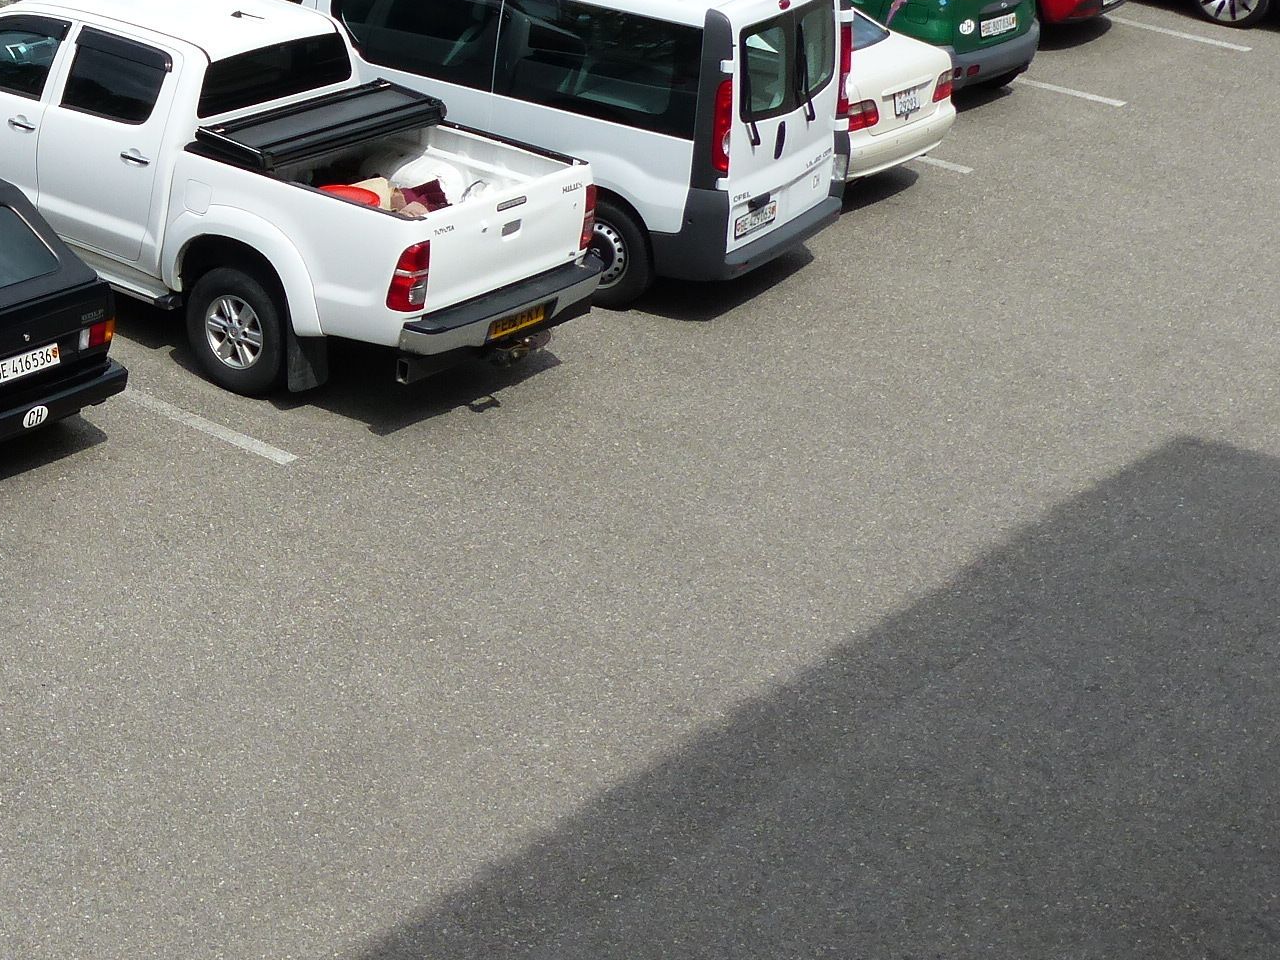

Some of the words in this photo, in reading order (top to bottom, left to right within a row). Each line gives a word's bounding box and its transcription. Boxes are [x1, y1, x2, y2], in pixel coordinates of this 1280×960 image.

[961, 20, 973, 33] CH
[733, 191, 751, 203] OPEL
[11, 348, 52, 376] 416536
[27, 407, 44, 427] CH
